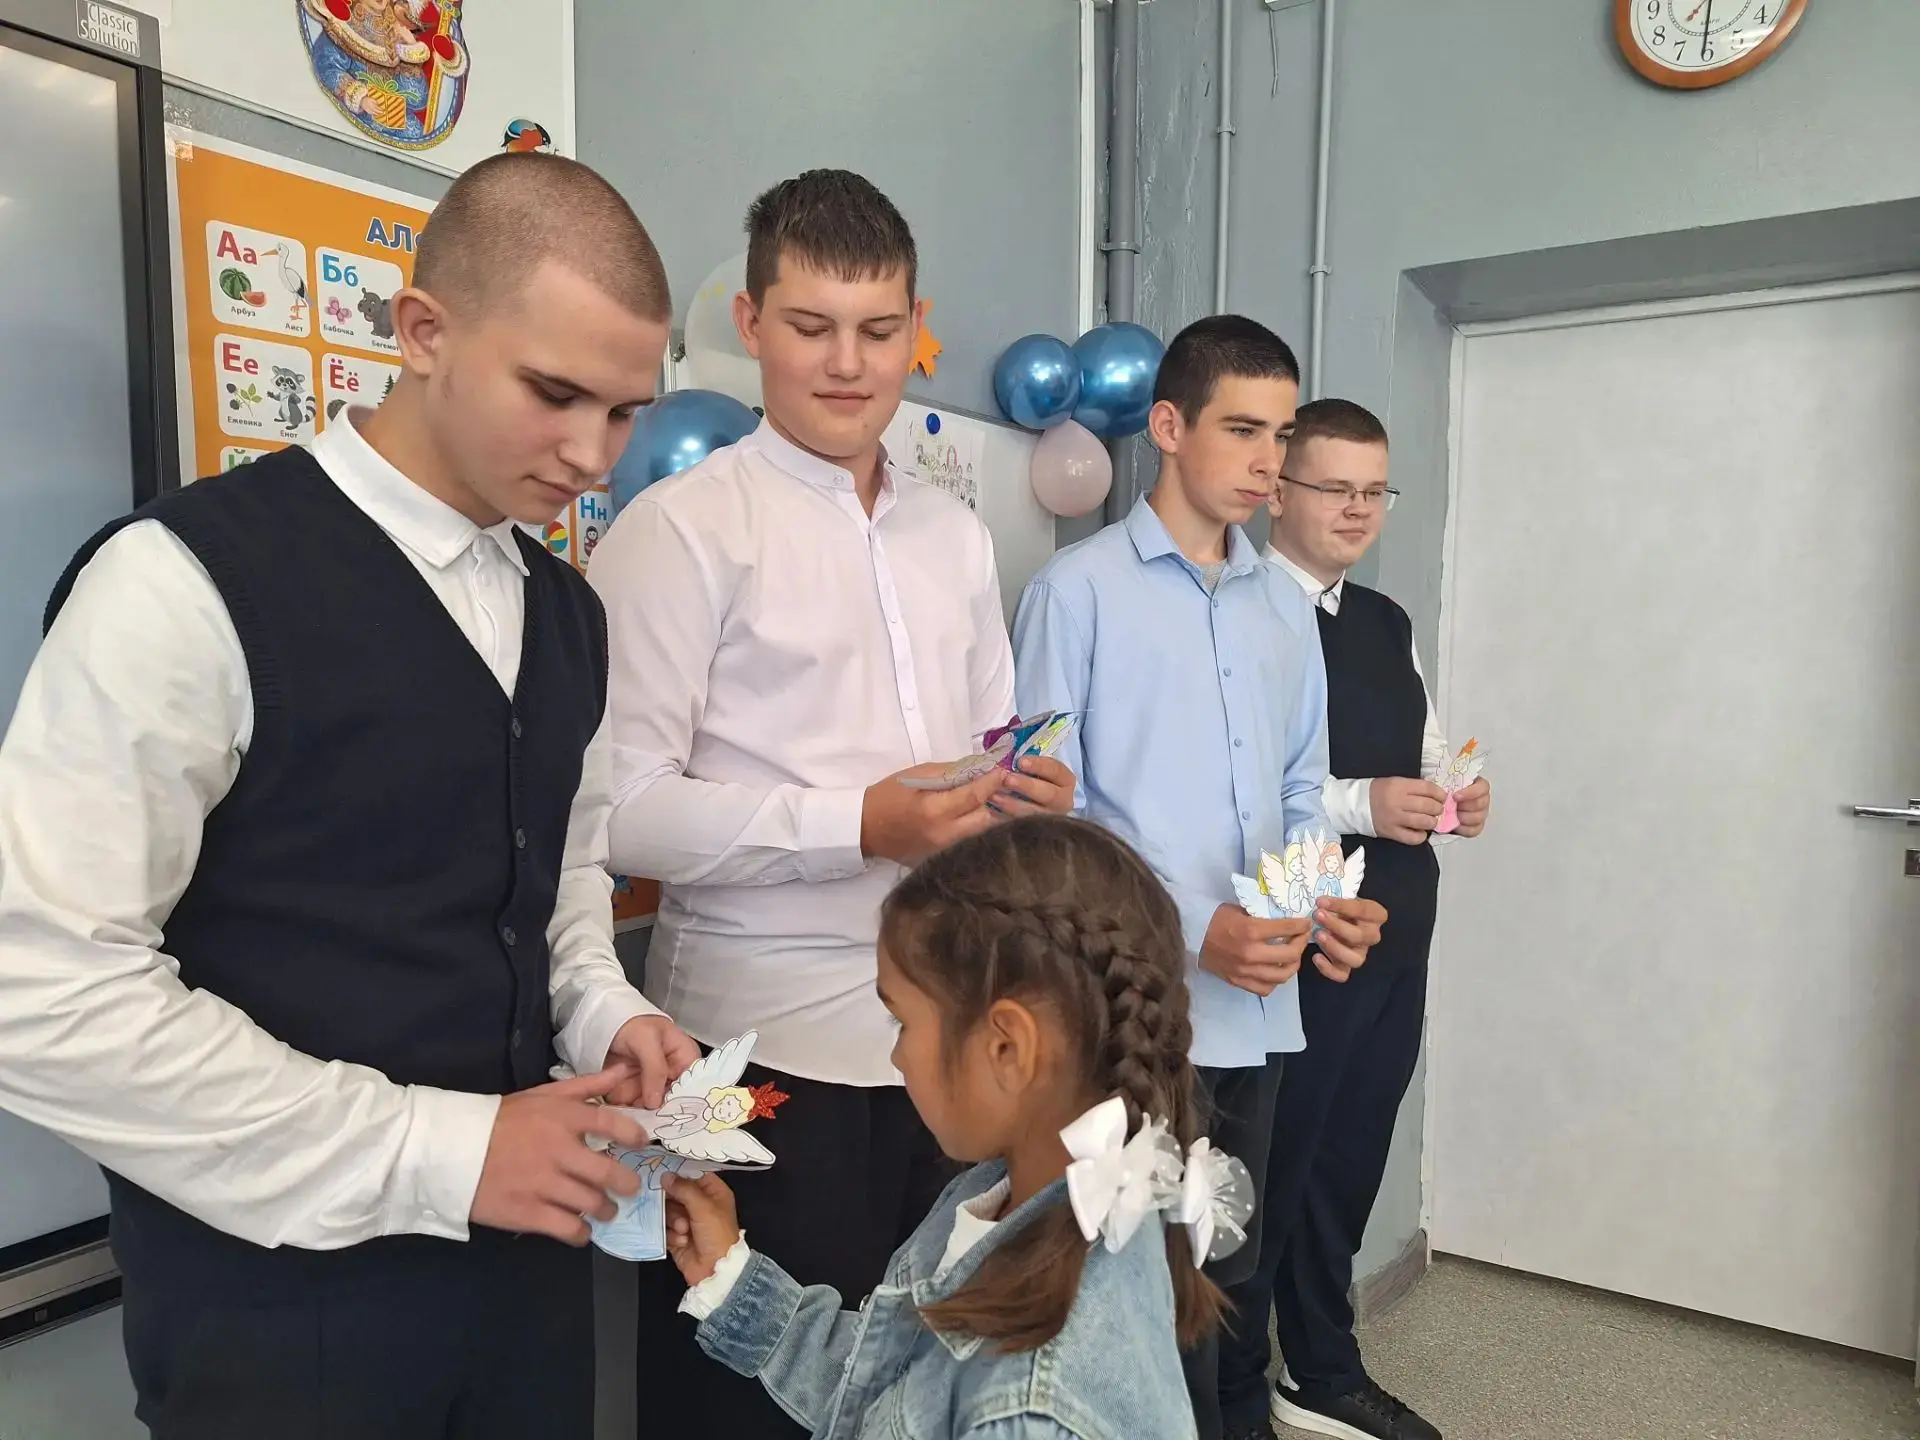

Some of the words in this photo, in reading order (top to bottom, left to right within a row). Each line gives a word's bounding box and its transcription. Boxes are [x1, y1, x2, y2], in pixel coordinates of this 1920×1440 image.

[89, 4, 133, 35] Classic
[1753, 4, 1768, 25] 4
[80, 20, 138, 55] Solution
[1652, 25, 1666, 46] 8
[1673, 40, 1687, 62] 7
[1700, 41, 1714, 62] 6
[365, 217, 422, 253] АЛ
[216, 230, 258, 265] Аа
[322, 253, 359, 287] Бб
[230, 305, 257, 318] Арбуз
[284, 322, 304, 333] Аист
[323, 323, 355, 336] Бабочка
[222, 341, 259, 376] Ее
[329, 357, 360, 393] Ёё
[227, 415, 263, 428] Ежевика
[280, 429, 299, 440] Енот
[580, 496, 607, 521] Нн
